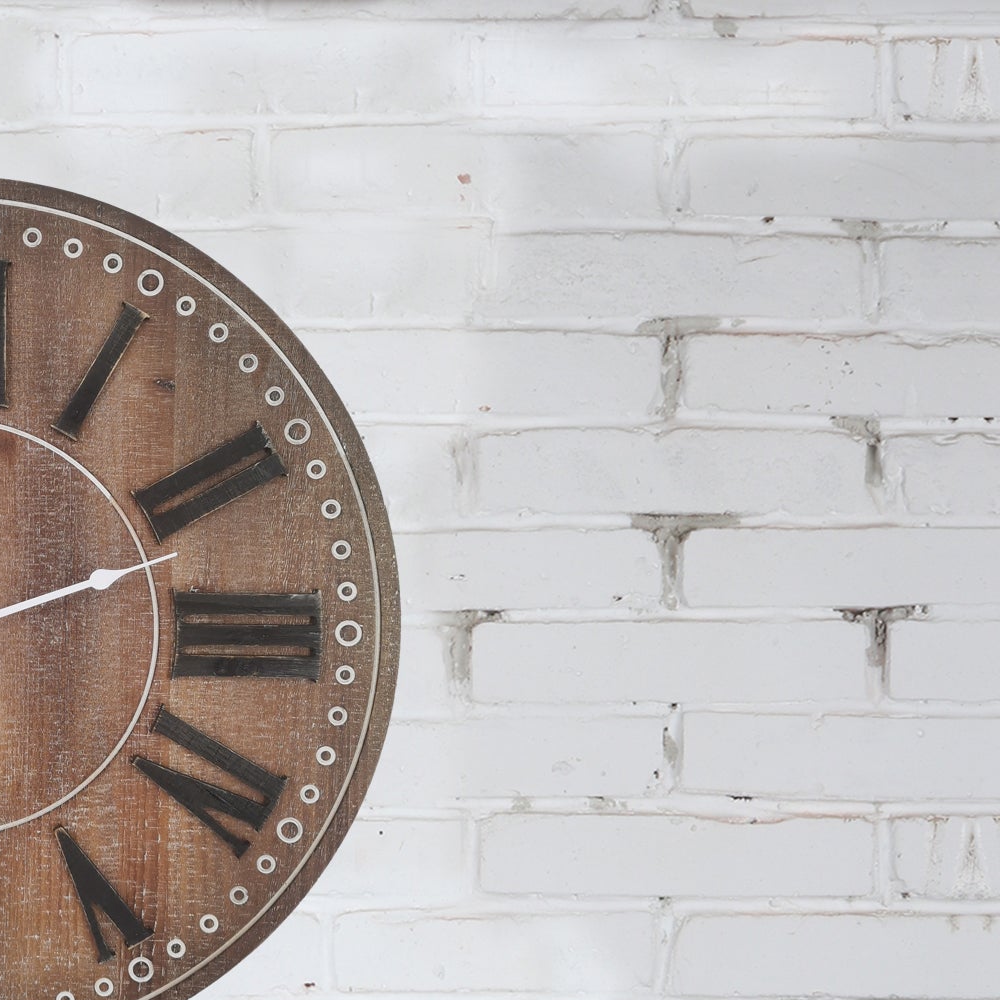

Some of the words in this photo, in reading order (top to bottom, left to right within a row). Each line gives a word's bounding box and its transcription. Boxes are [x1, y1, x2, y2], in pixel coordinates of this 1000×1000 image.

[50, 301, 151, 441] I
[130, 420, 289, 544] II
[171, 588, 322, 682] III
[129, 705, 289, 859] IV
[53, 827, 154, 963] V
